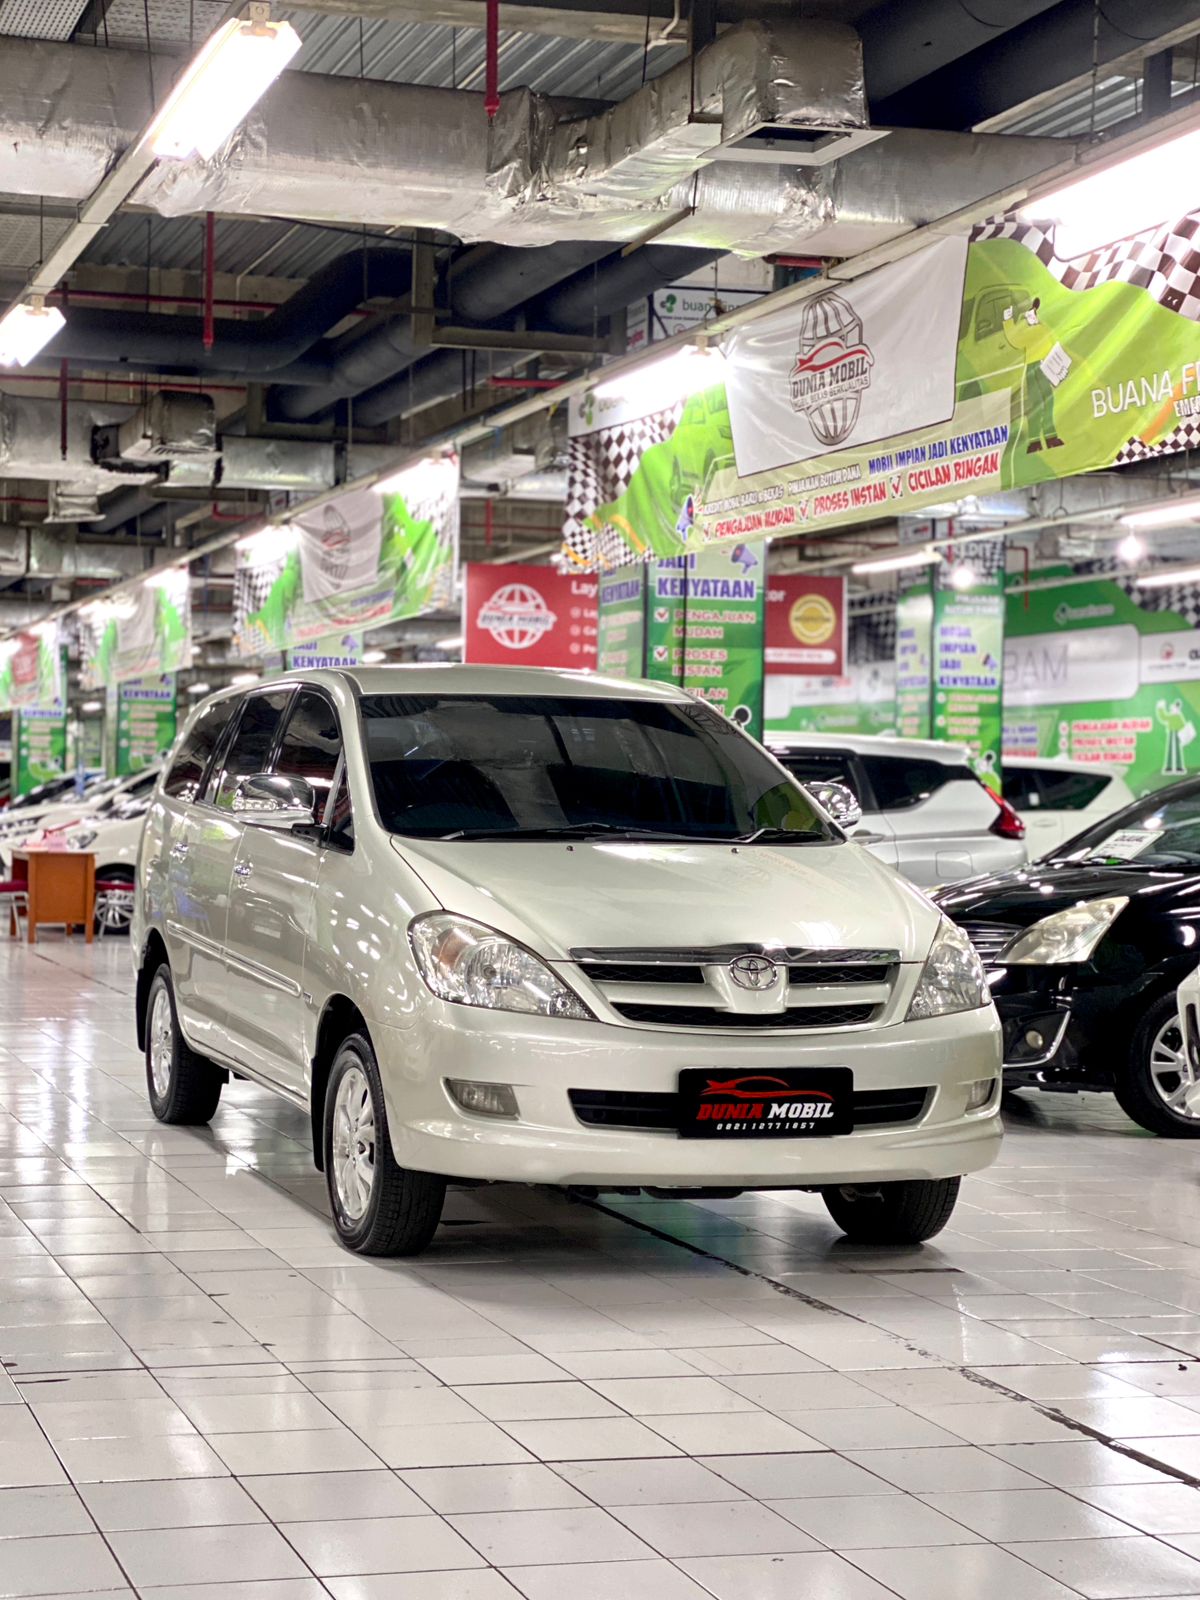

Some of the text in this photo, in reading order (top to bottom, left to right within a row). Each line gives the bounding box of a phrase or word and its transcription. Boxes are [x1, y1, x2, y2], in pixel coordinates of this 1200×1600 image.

[792, 357, 867, 399] DUNIA MOBIL
[1091, 370, 1173, 418] BUANA
[895, 446, 926, 466] IMPIAN
[928, 441, 948, 460] JADI
[950, 425, 1008, 455] KENYATAAN
[908, 451, 999, 492] CICILAN RINGAN
[814, 481, 886, 515] PROSES INSTAN
[715, 506, 795, 539] PENGAJUAN MUDAH
[658, 578, 754, 599] KENYATAAN
[293, 656, 357, 667] KENYATAAN
[696, 1102, 834, 1121] DUNIA MOBIL
